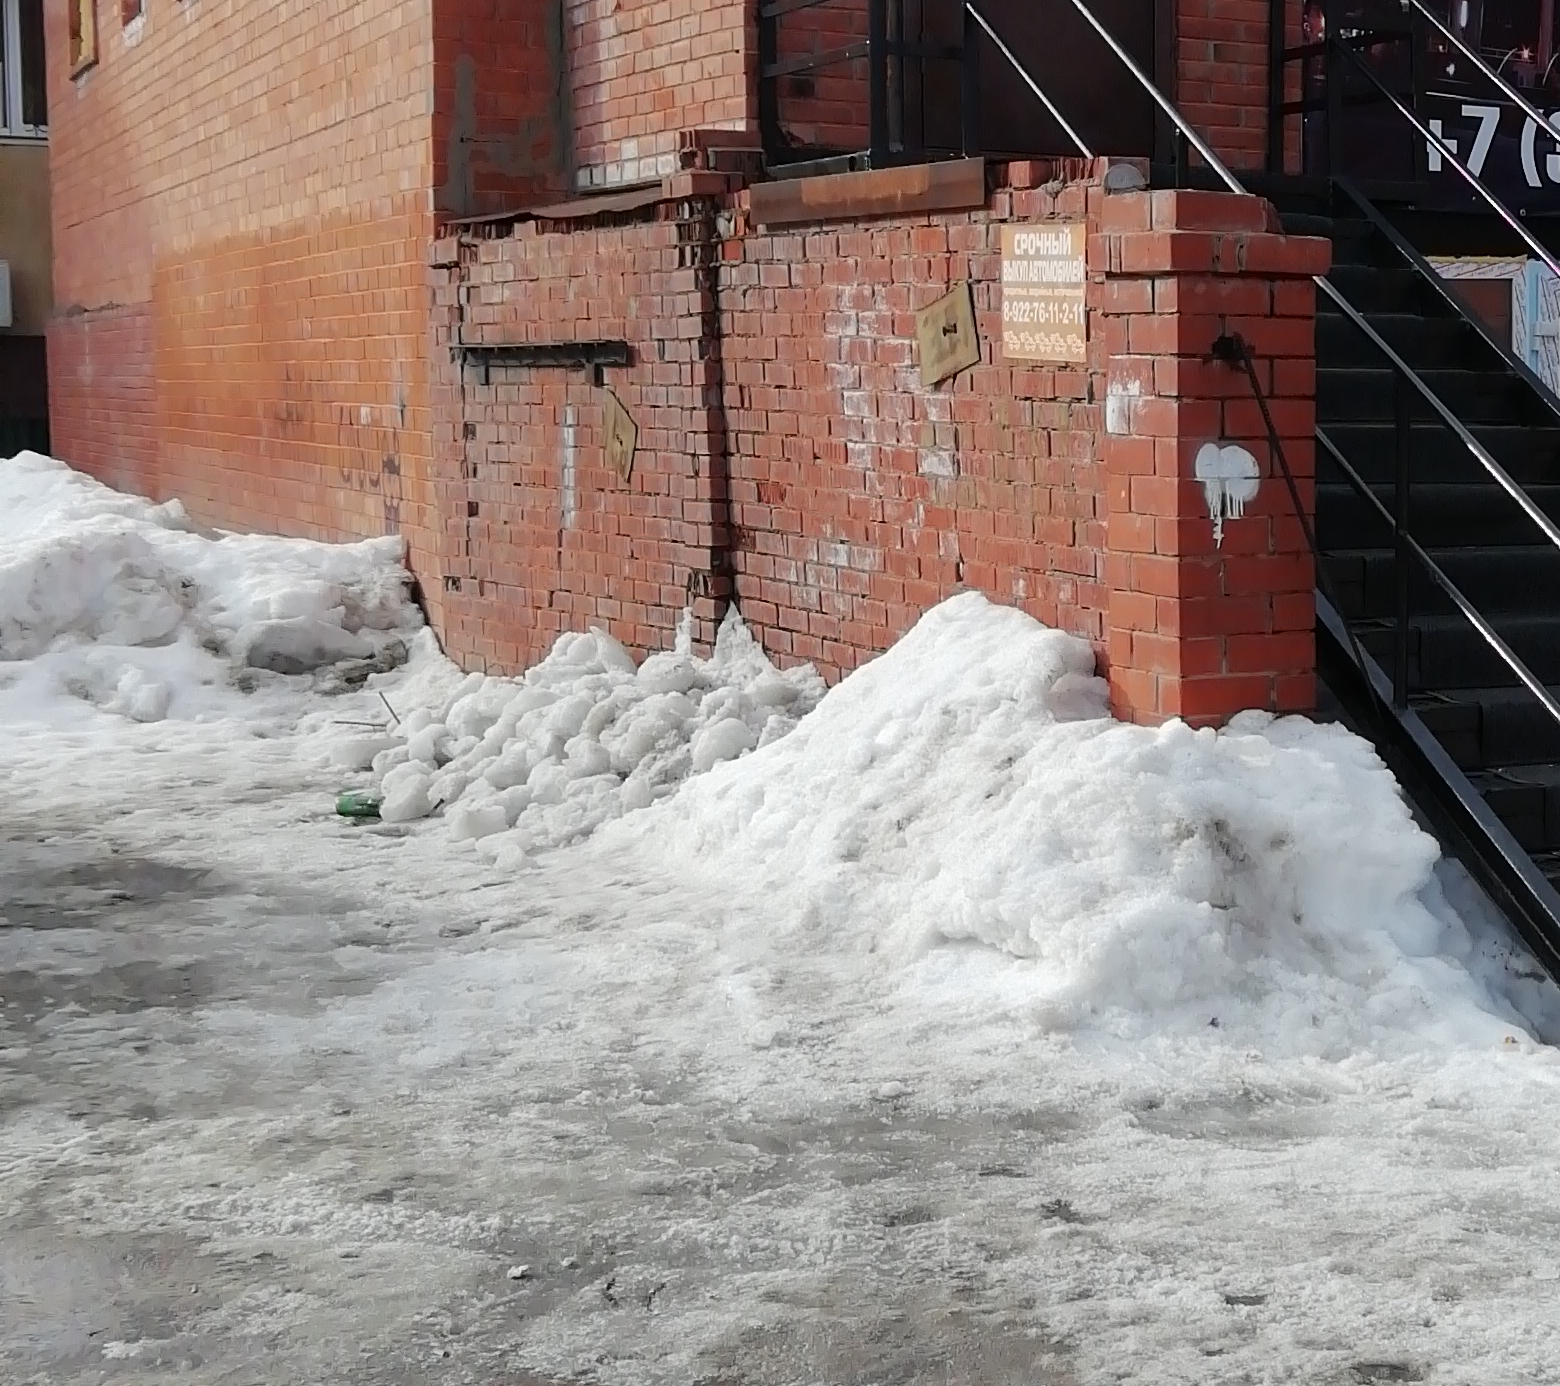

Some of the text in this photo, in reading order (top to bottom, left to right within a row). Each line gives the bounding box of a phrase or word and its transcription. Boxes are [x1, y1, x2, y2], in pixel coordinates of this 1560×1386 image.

[1426, 105, 1500, 179] +7
[1014, 228, 1072, 255] СРОЧНЫЙ
[1003, 255, 1084, 283] ВЫКУП АВТОМОБИЛЕЙ
